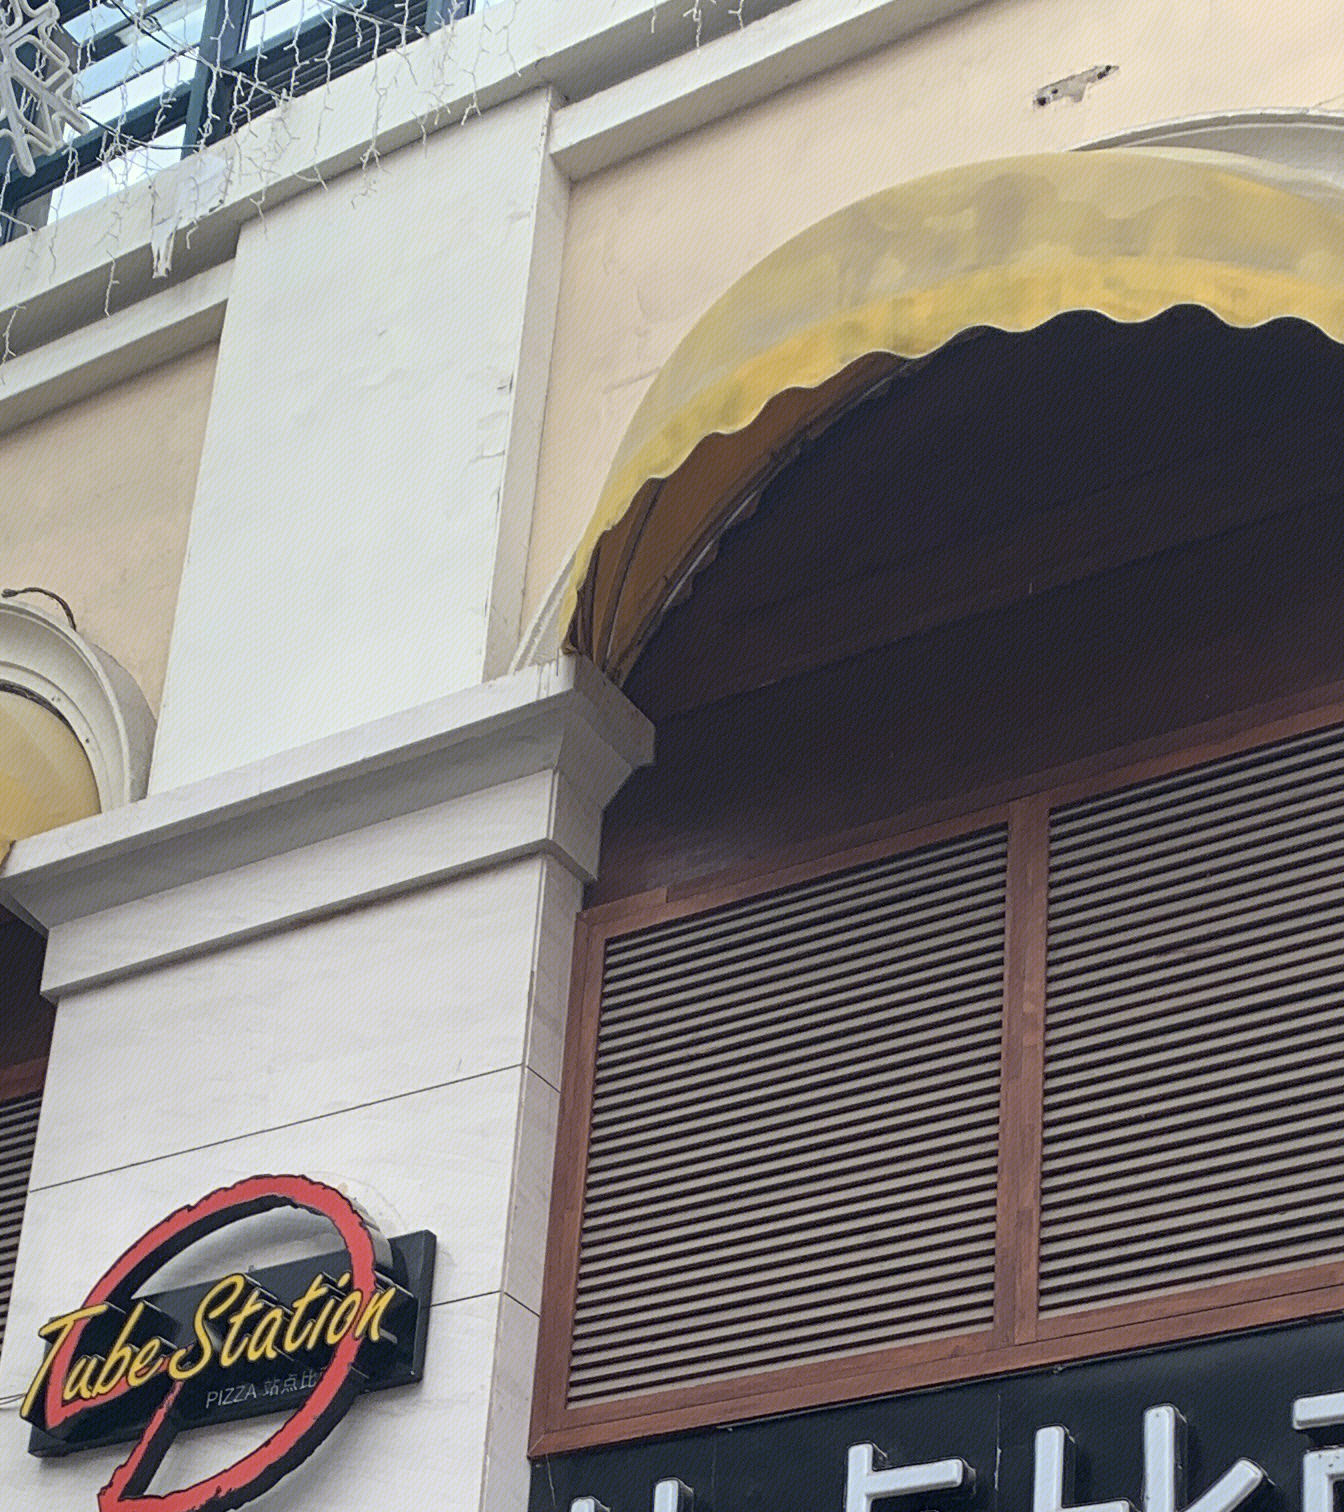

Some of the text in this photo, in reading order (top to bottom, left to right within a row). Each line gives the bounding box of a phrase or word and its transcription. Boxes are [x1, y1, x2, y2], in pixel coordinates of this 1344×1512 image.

[206, 1367, 327, 1409] PIZZA 站点比
